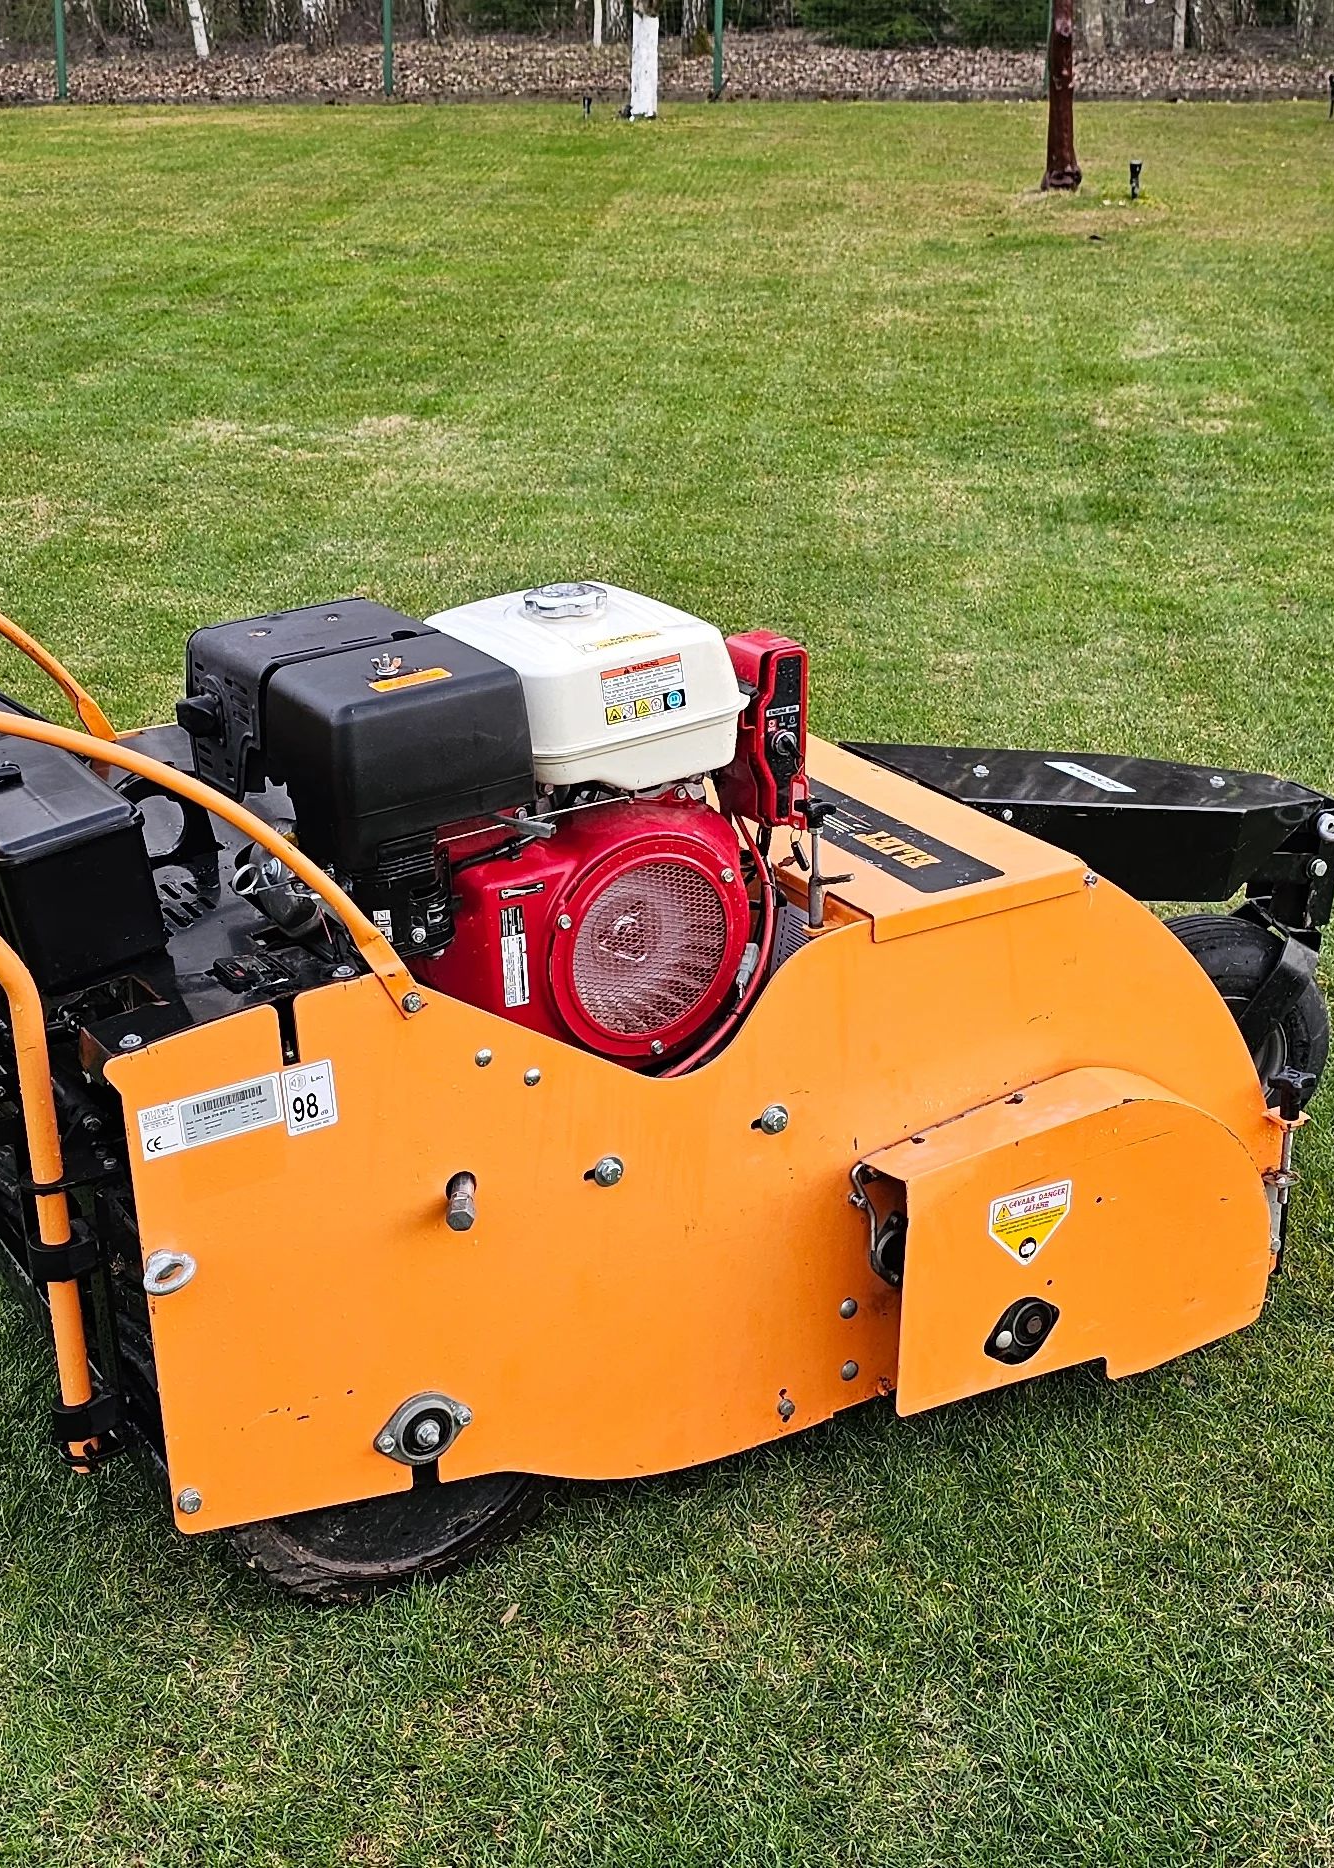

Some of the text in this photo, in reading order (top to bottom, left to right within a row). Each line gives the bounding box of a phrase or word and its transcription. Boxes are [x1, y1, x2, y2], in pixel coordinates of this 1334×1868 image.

[292, 1092, 319, 1123] 98
[146, 1135, 164, 1153] CE
[1038, 1187, 1066, 1201] DANGER
